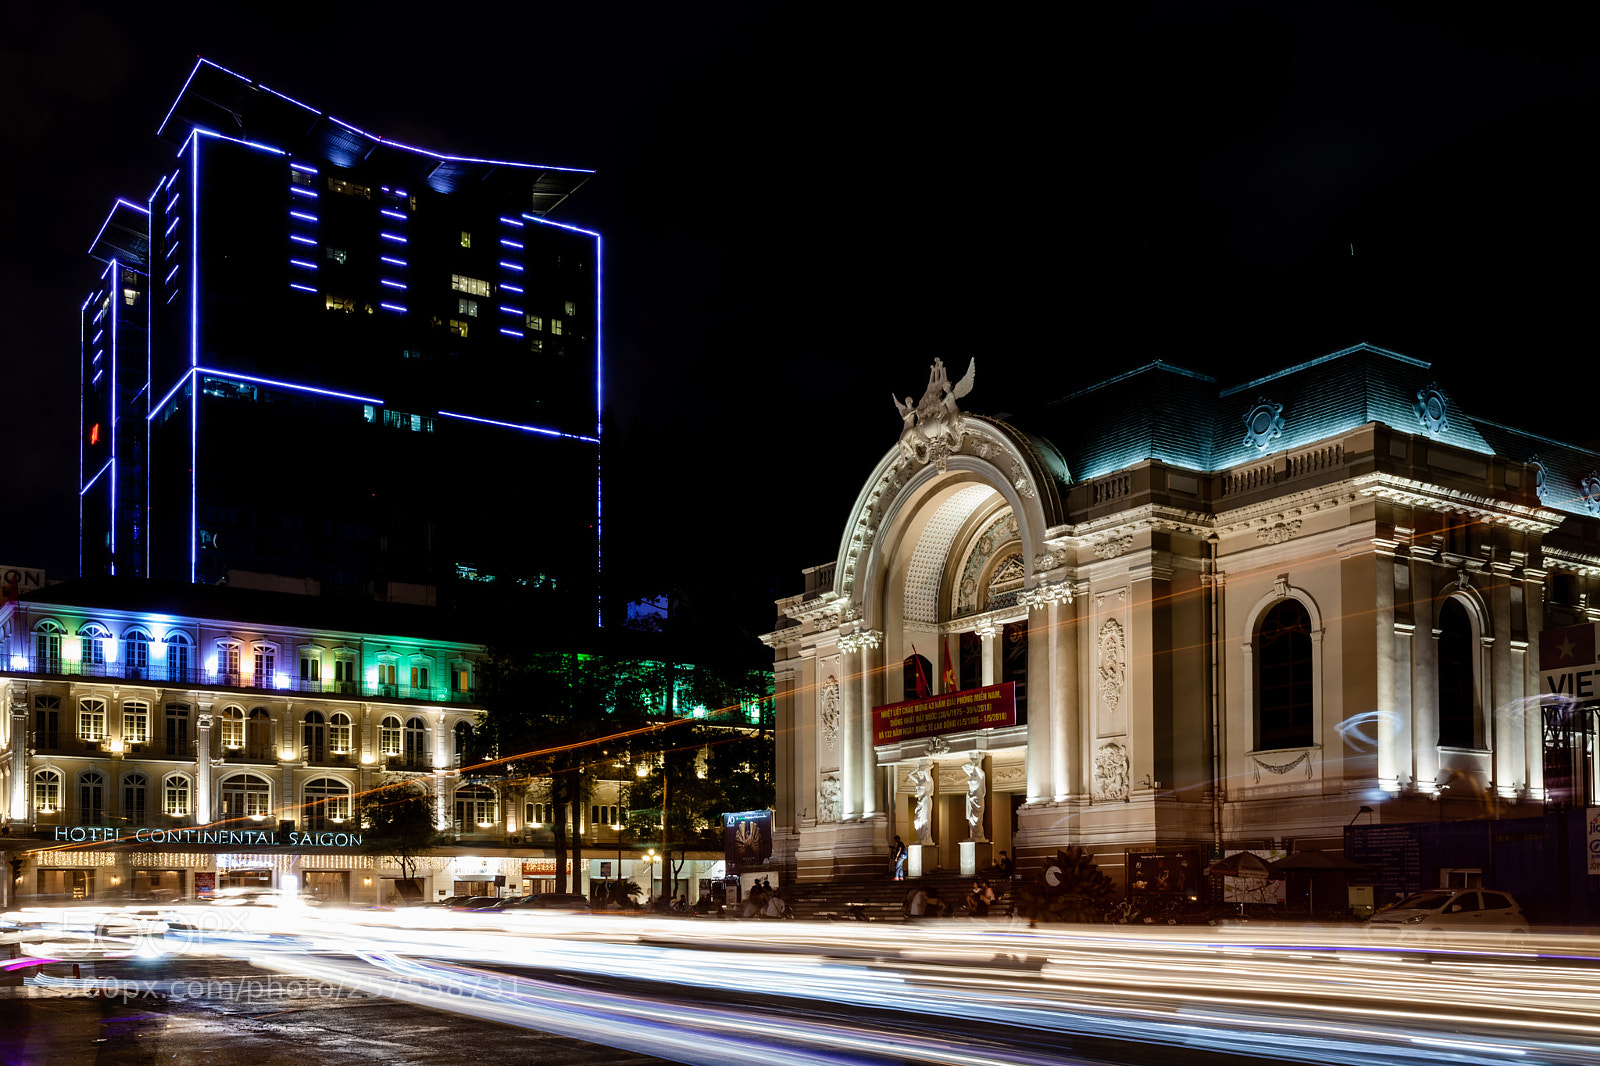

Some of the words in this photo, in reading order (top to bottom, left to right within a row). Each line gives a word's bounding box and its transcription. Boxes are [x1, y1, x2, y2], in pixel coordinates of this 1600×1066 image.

[0, 570, 39, 586] ON
[55, 826, 125, 842] HOTEL
[136, 828, 279, 845] CONTINENTAL
[289, 832, 362, 847] SAIGON
